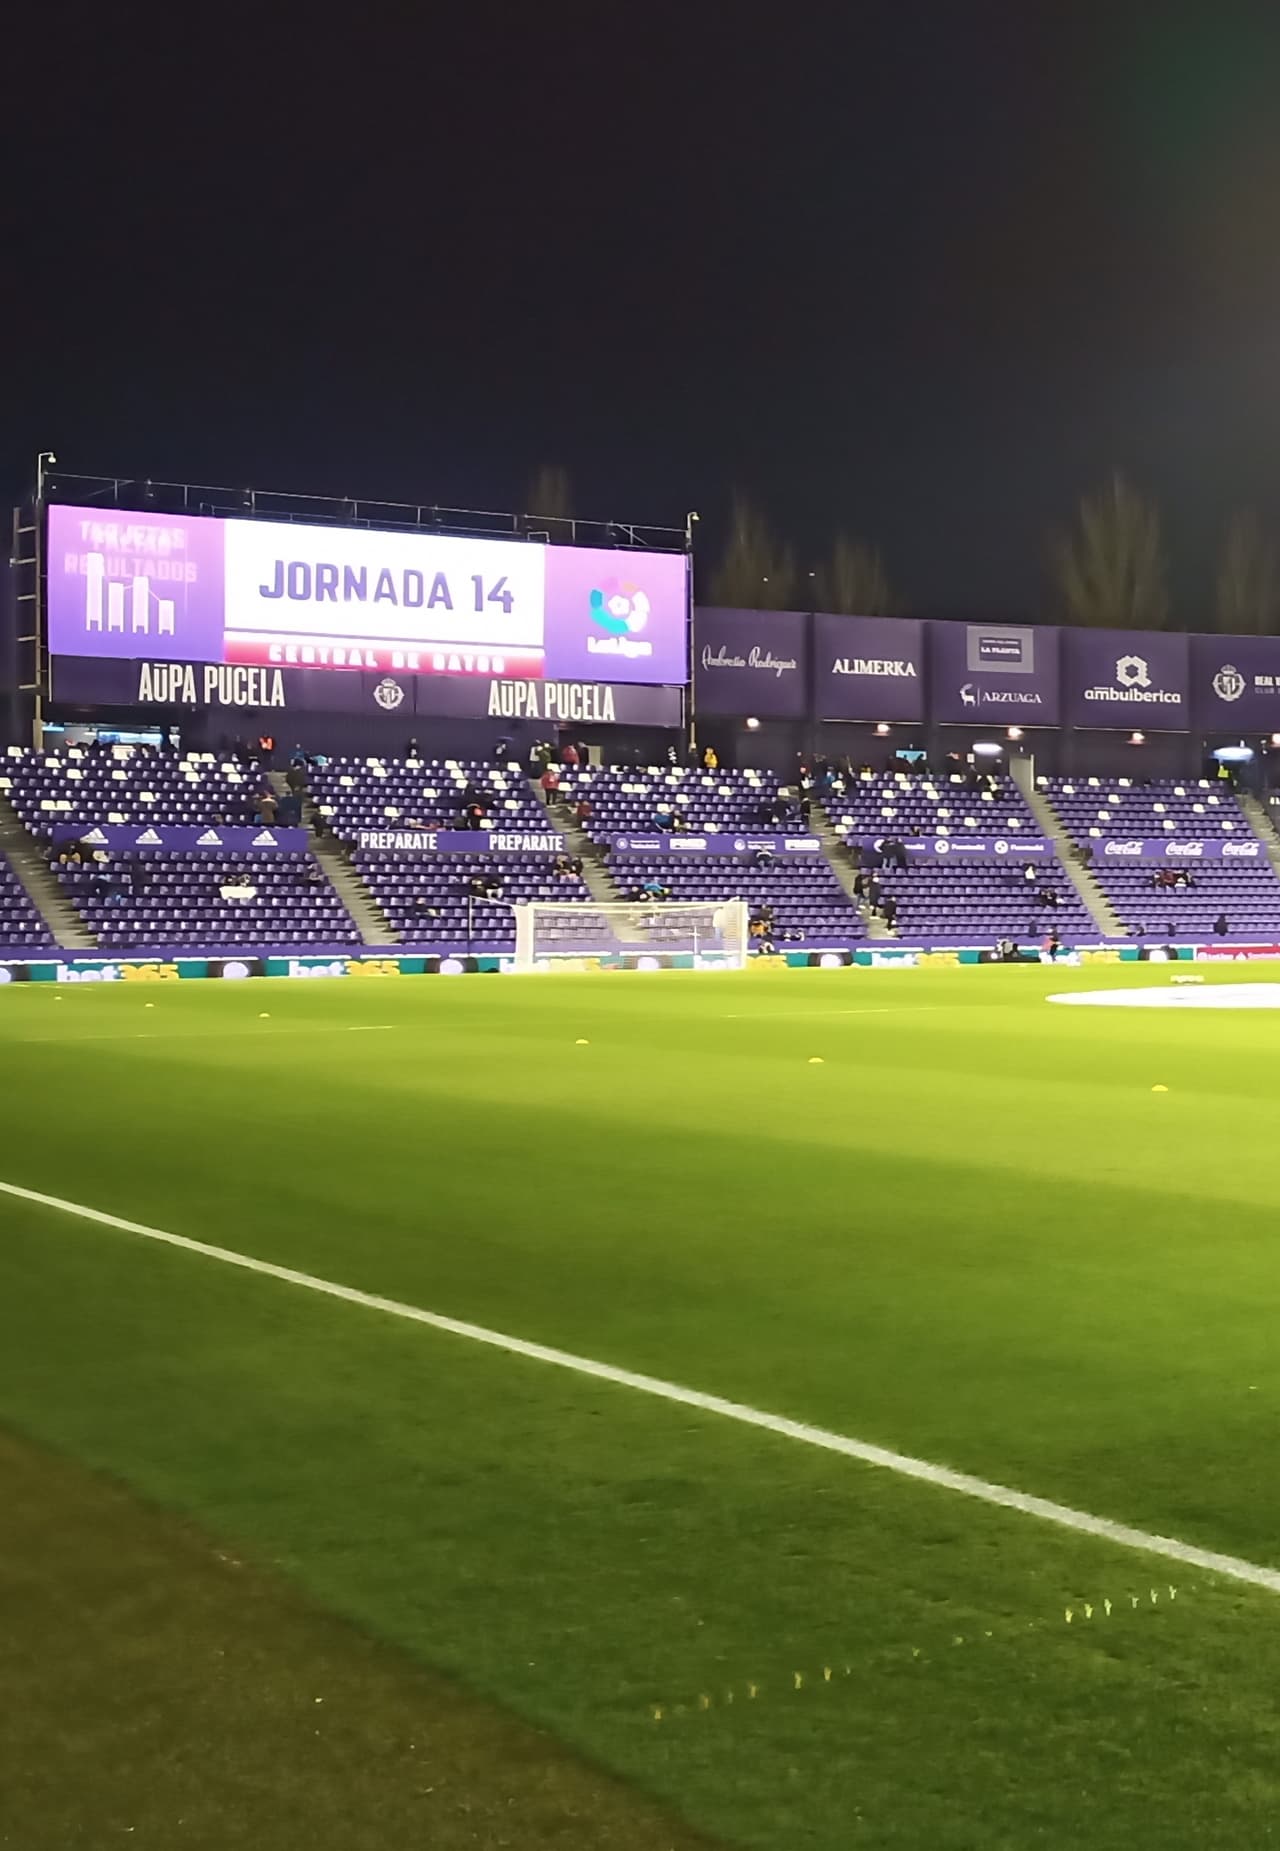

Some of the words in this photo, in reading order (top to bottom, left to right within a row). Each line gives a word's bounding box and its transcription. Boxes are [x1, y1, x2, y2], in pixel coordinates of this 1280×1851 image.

[64, 552, 198, 583] REULTADOS
[259, 560, 454, 610] JORNADA
[471, 575, 514, 613] 14
[832, 658, 917, 677] ALIMERKA
[203, 665, 285, 707] PUCELA
[544, 682, 616, 721] PUCELA
[983, 690, 1043, 704] ARZUAGA
[360, 831, 437, 850] PREPARATE
[489, 833, 564, 851] PREPARATE
[56, 964, 180, 983] bet365
[288, 960, 400, 978] bet365
